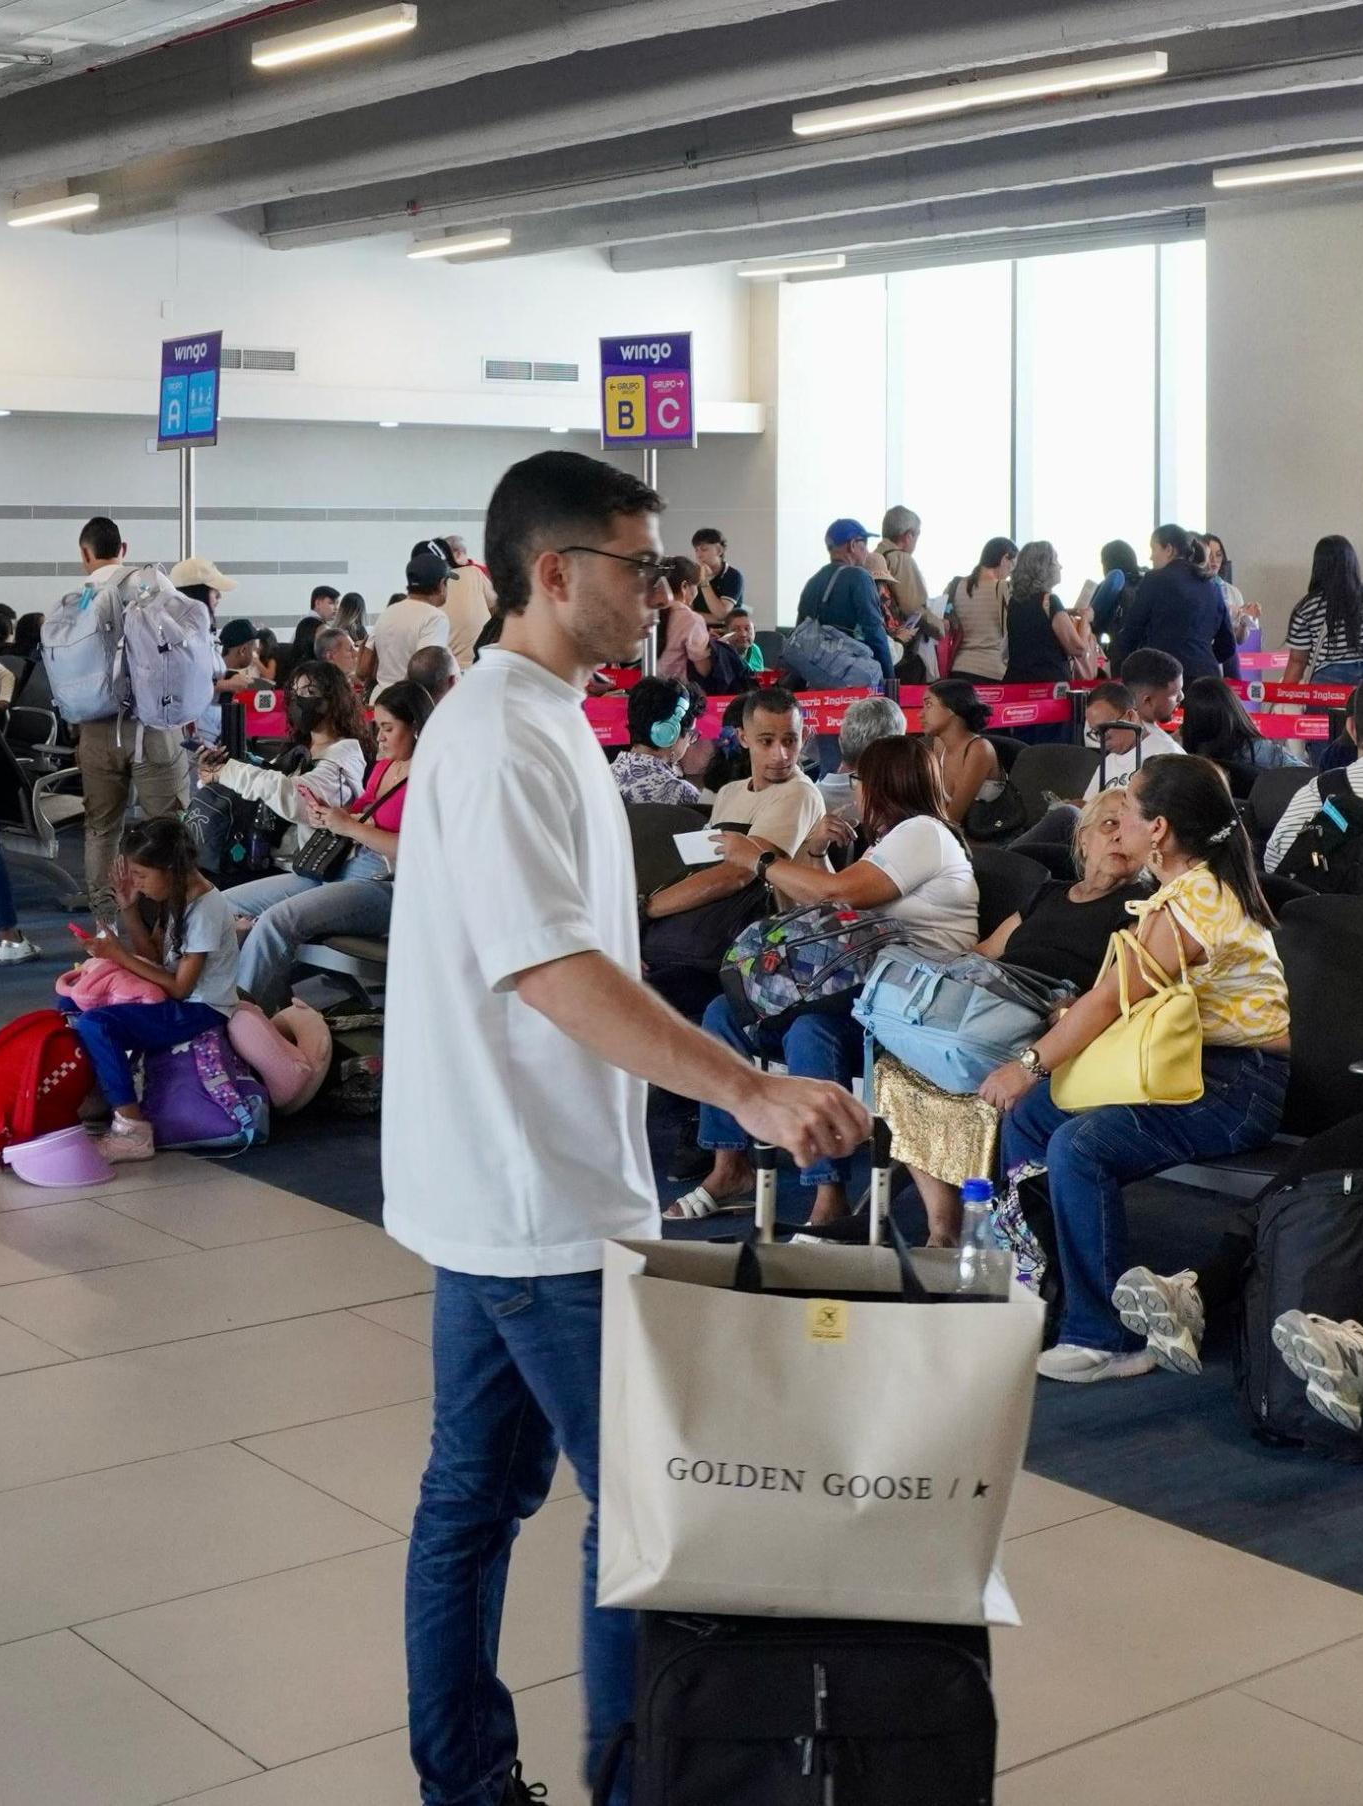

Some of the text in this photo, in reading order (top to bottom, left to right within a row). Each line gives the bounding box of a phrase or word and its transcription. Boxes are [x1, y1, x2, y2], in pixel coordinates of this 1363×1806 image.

[174, 342, 208, 363] wingo
[620, 343, 672, 364] wingo
[167, 399, 181, 430] A
[618, 400, 635, 430] B
[657, 397, 680, 430] C
[667, 1457, 806, 1493] GOLDEN
[823, 1473, 933, 1500] GOOSE
